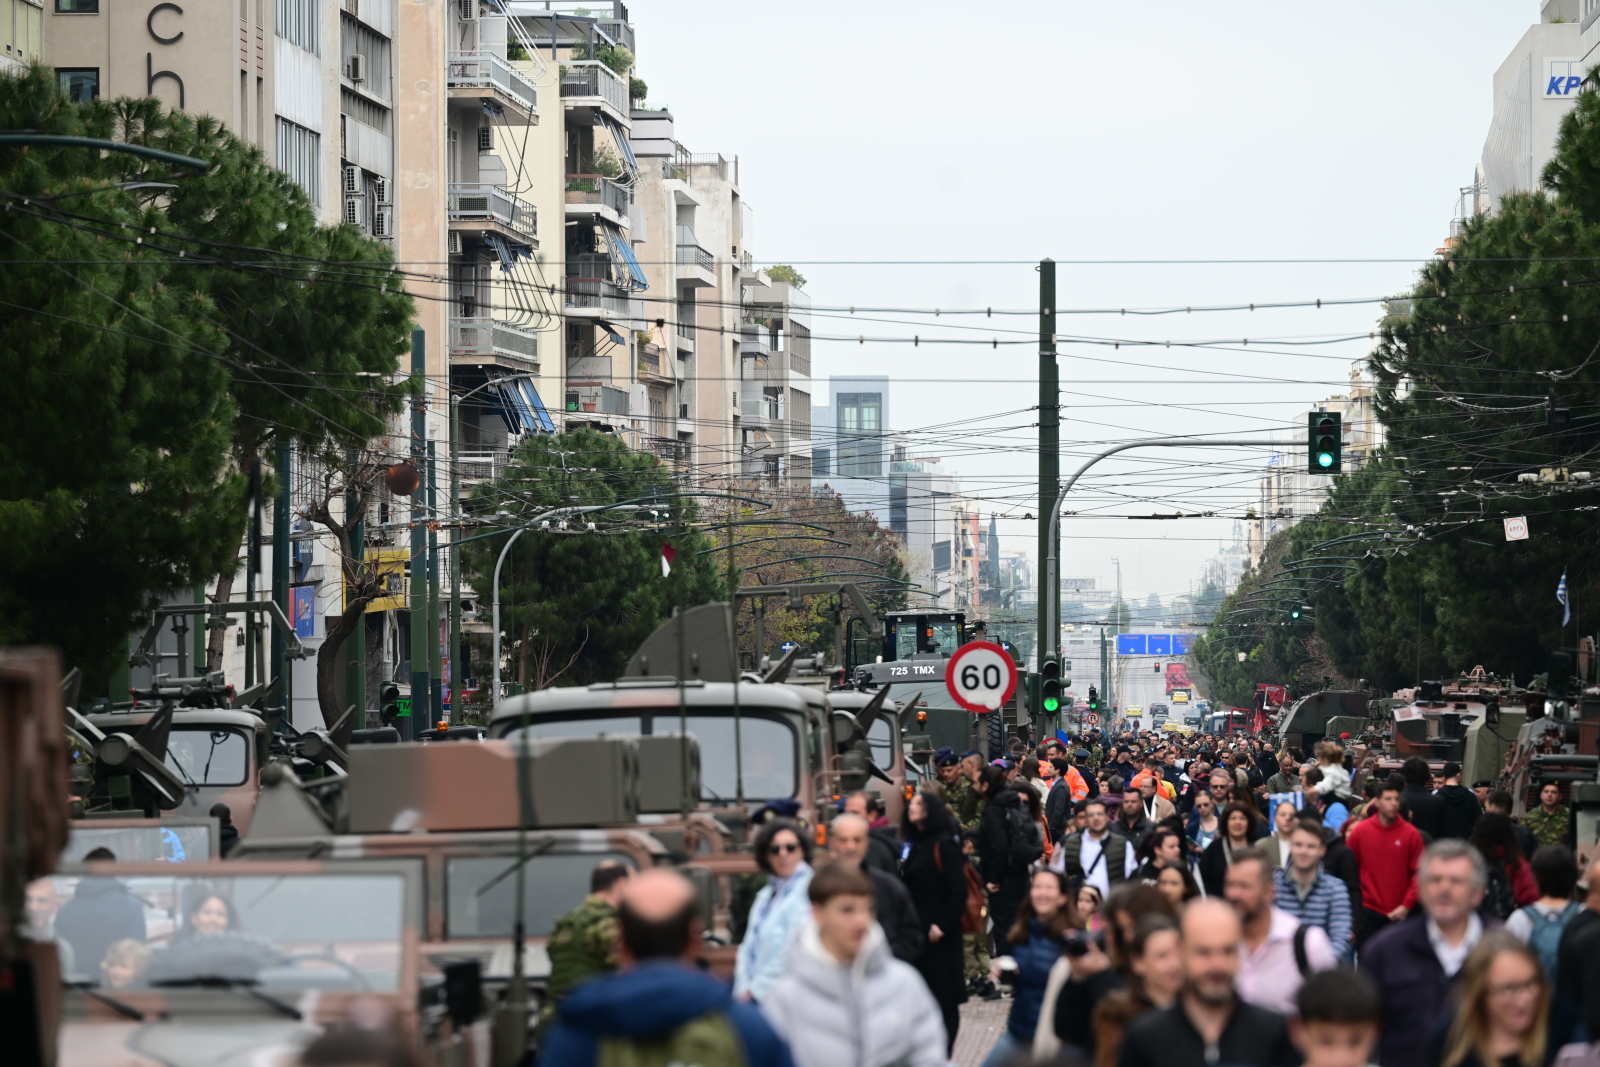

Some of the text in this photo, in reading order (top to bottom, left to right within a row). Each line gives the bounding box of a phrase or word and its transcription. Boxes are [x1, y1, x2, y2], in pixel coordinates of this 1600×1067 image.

[1546, 76, 1582, 95] KP
[890, 665, 936, 676] 725 TMX
[961, 664, 1001, 690] 60
[396, 701, 411, 710] TM
